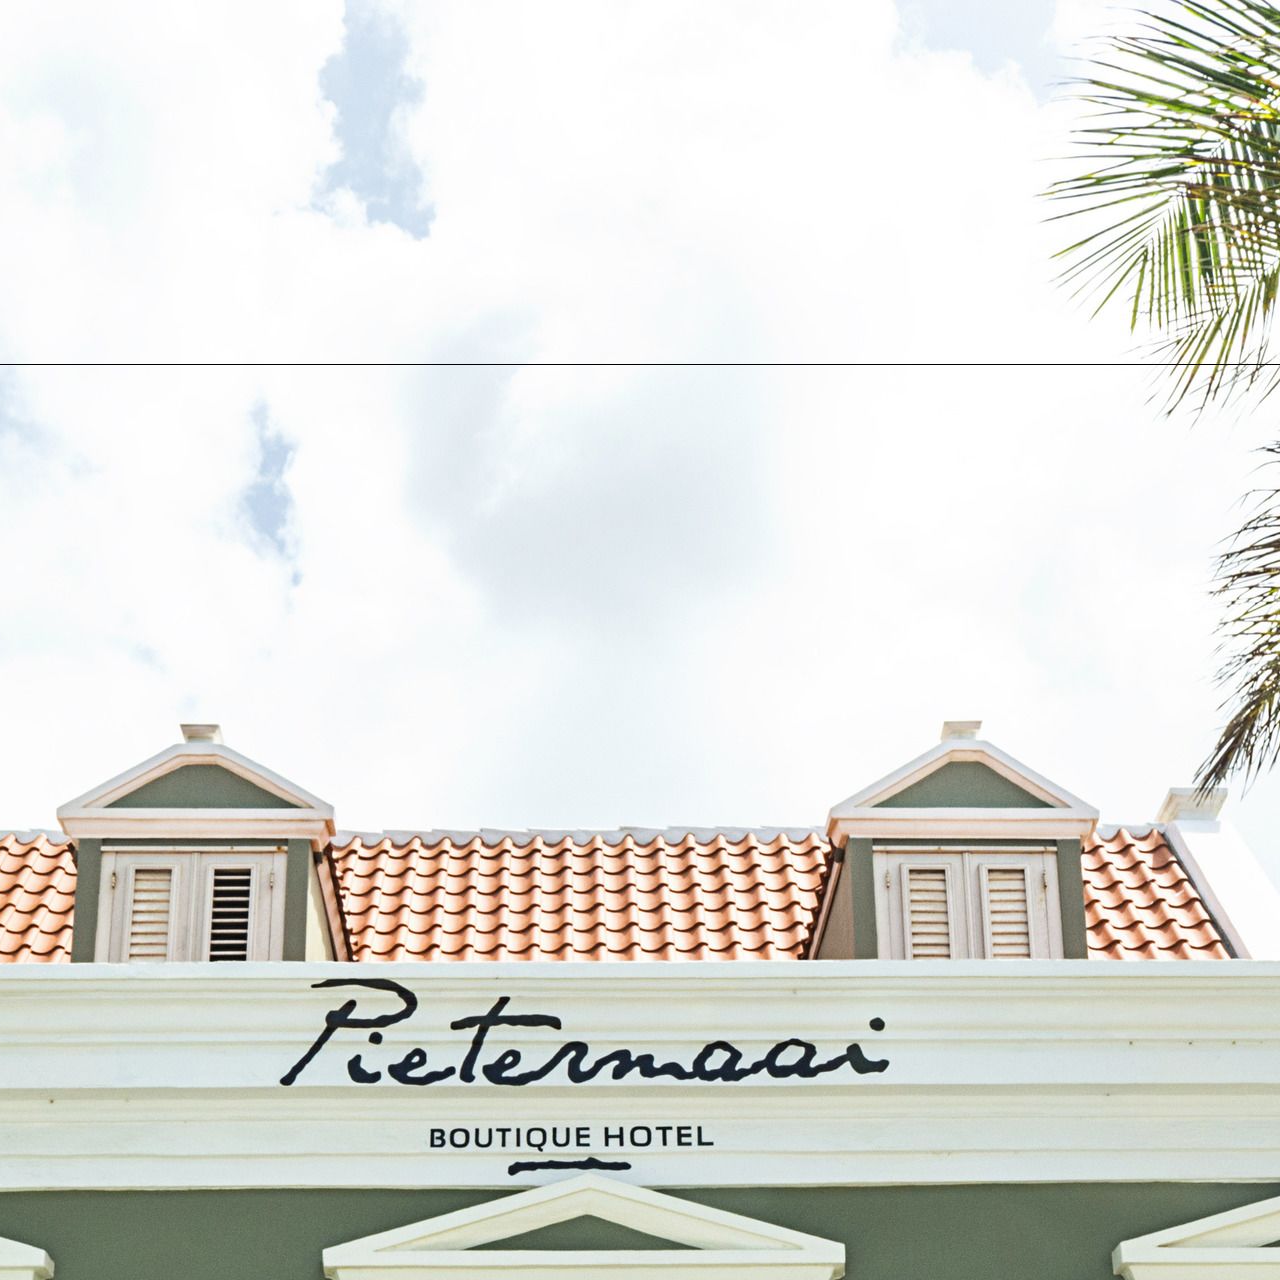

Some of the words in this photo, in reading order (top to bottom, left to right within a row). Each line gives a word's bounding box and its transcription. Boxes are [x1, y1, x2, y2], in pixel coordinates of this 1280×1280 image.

[280, 977, 890, 1086] Pietermaai
[429, 1127, 592, 1152] BOUTIQUE
[603, 1125, 715, 1148] HOTEL
